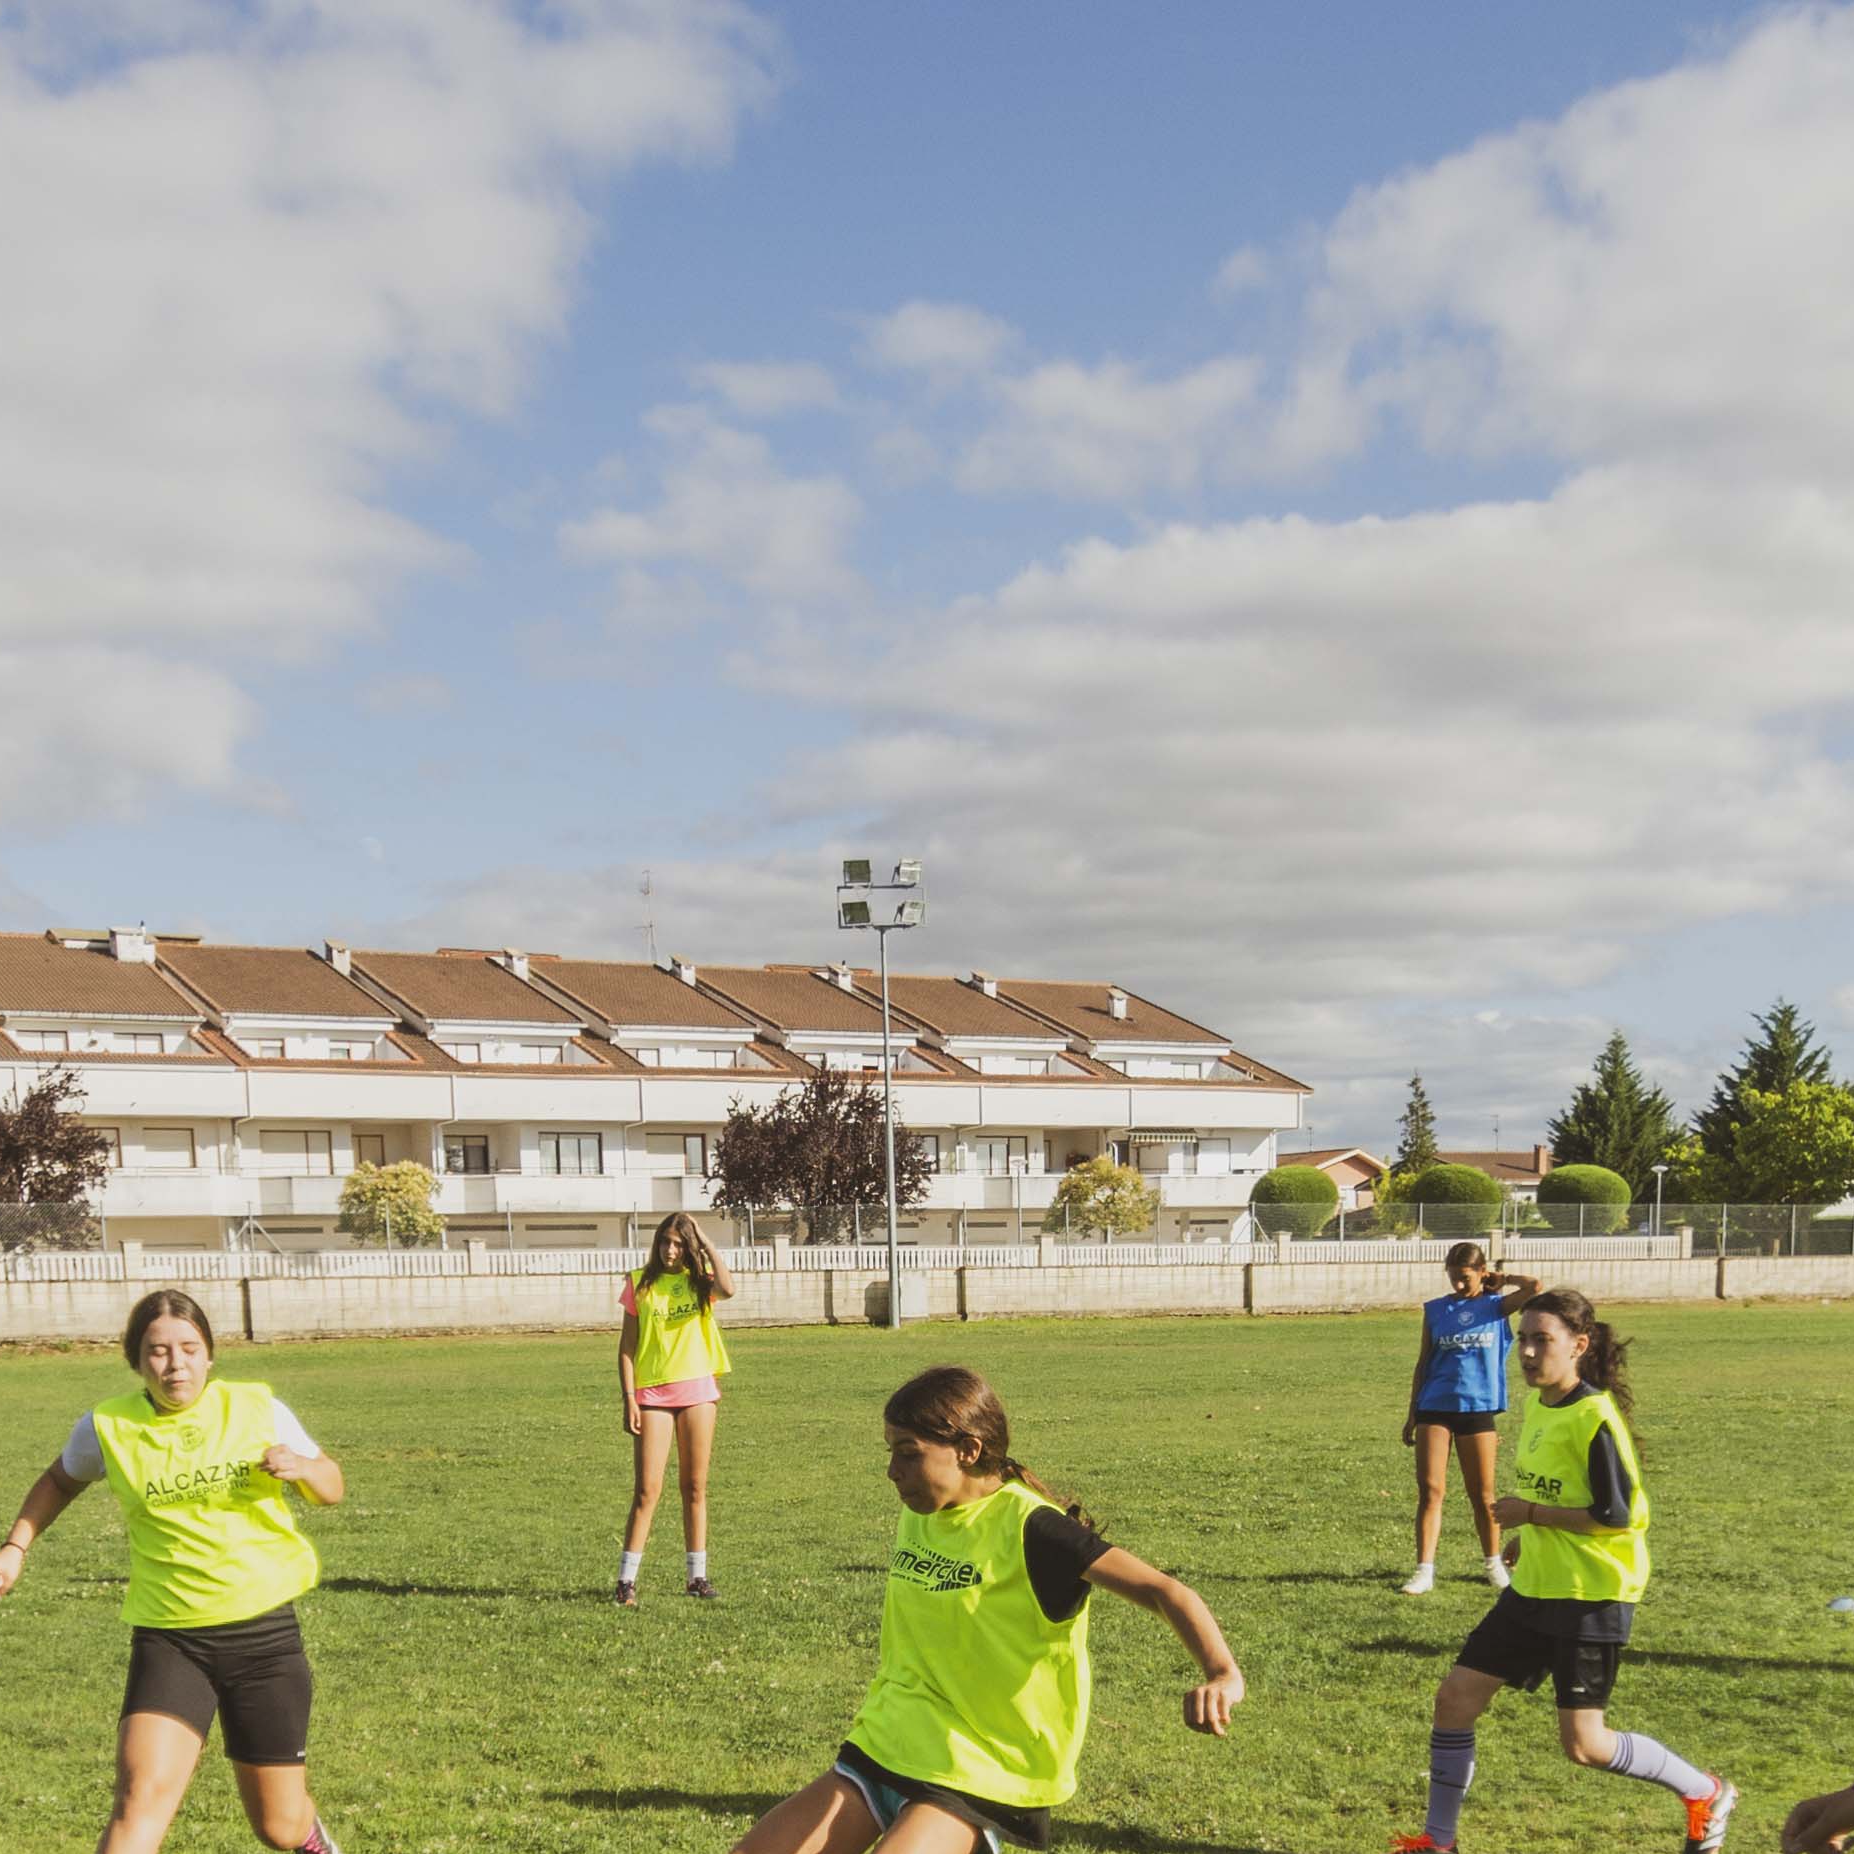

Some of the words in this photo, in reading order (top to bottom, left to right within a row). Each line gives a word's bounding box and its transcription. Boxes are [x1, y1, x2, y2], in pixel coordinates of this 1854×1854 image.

[653, 1303, 698, 1316] ALCAZA
[145, 1460, 251, 1499] ALCAZAR
[151, 1491, 184, 1508] CLUB
